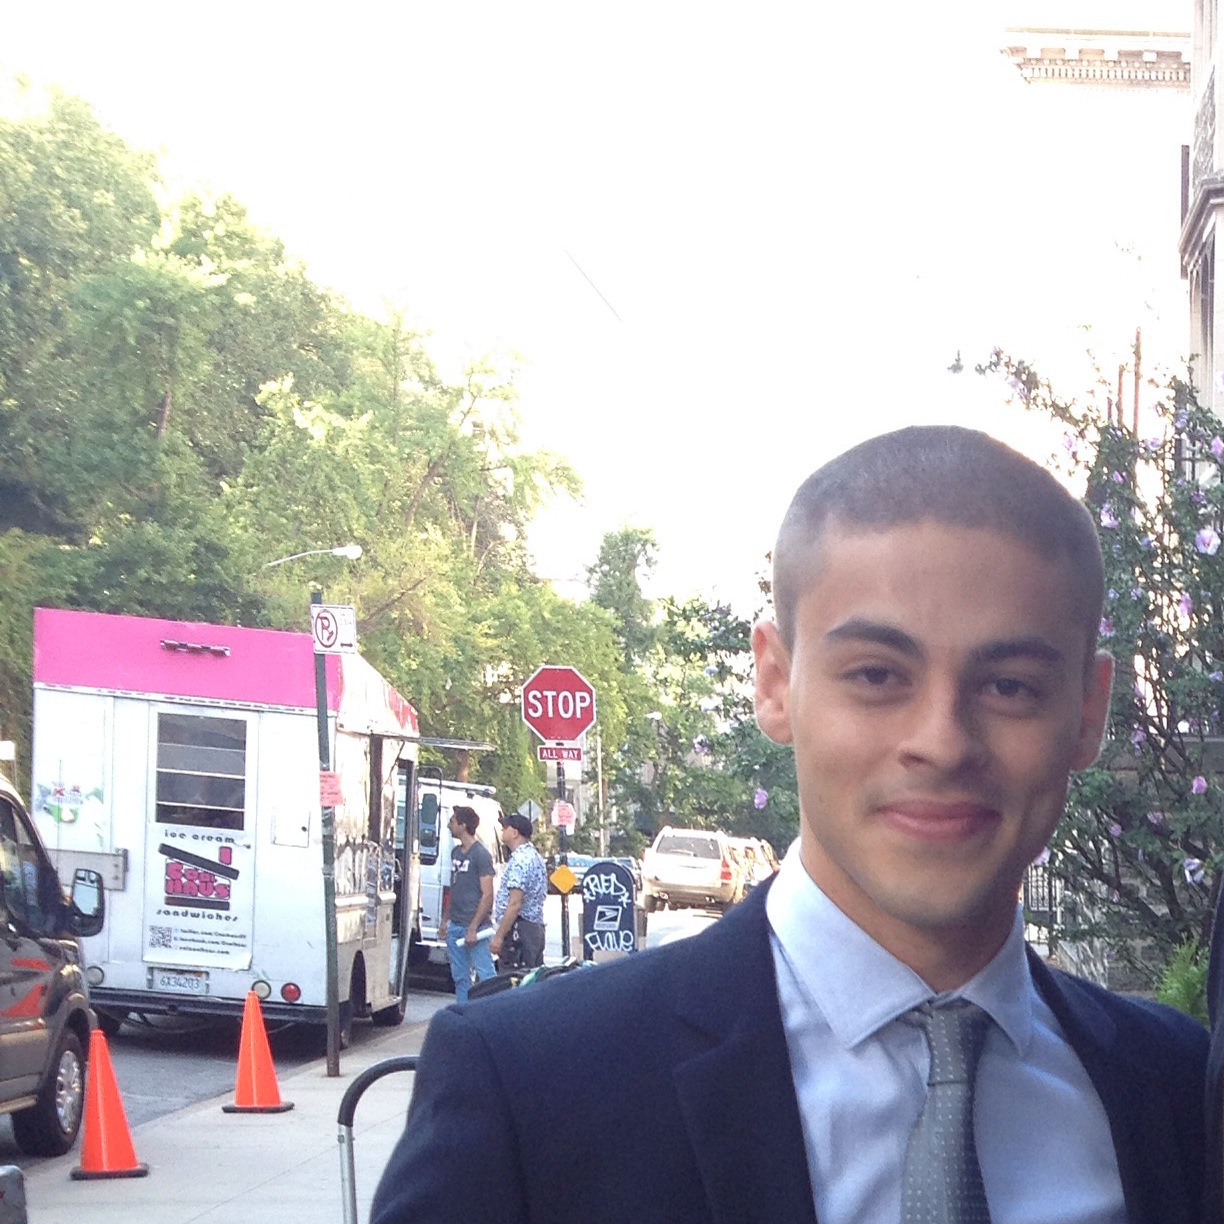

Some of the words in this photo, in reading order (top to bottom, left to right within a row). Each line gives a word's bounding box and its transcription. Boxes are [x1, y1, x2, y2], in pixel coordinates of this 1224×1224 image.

[528, 690, 591, 718] STOP
[542, 749, 558, 759] ALL
[561, 749, 579, 760] WAY
[164, 829, 187, 839] ice
[192, 832, 235, 844] cream
[156, 908, 239, 922] sandwiches
